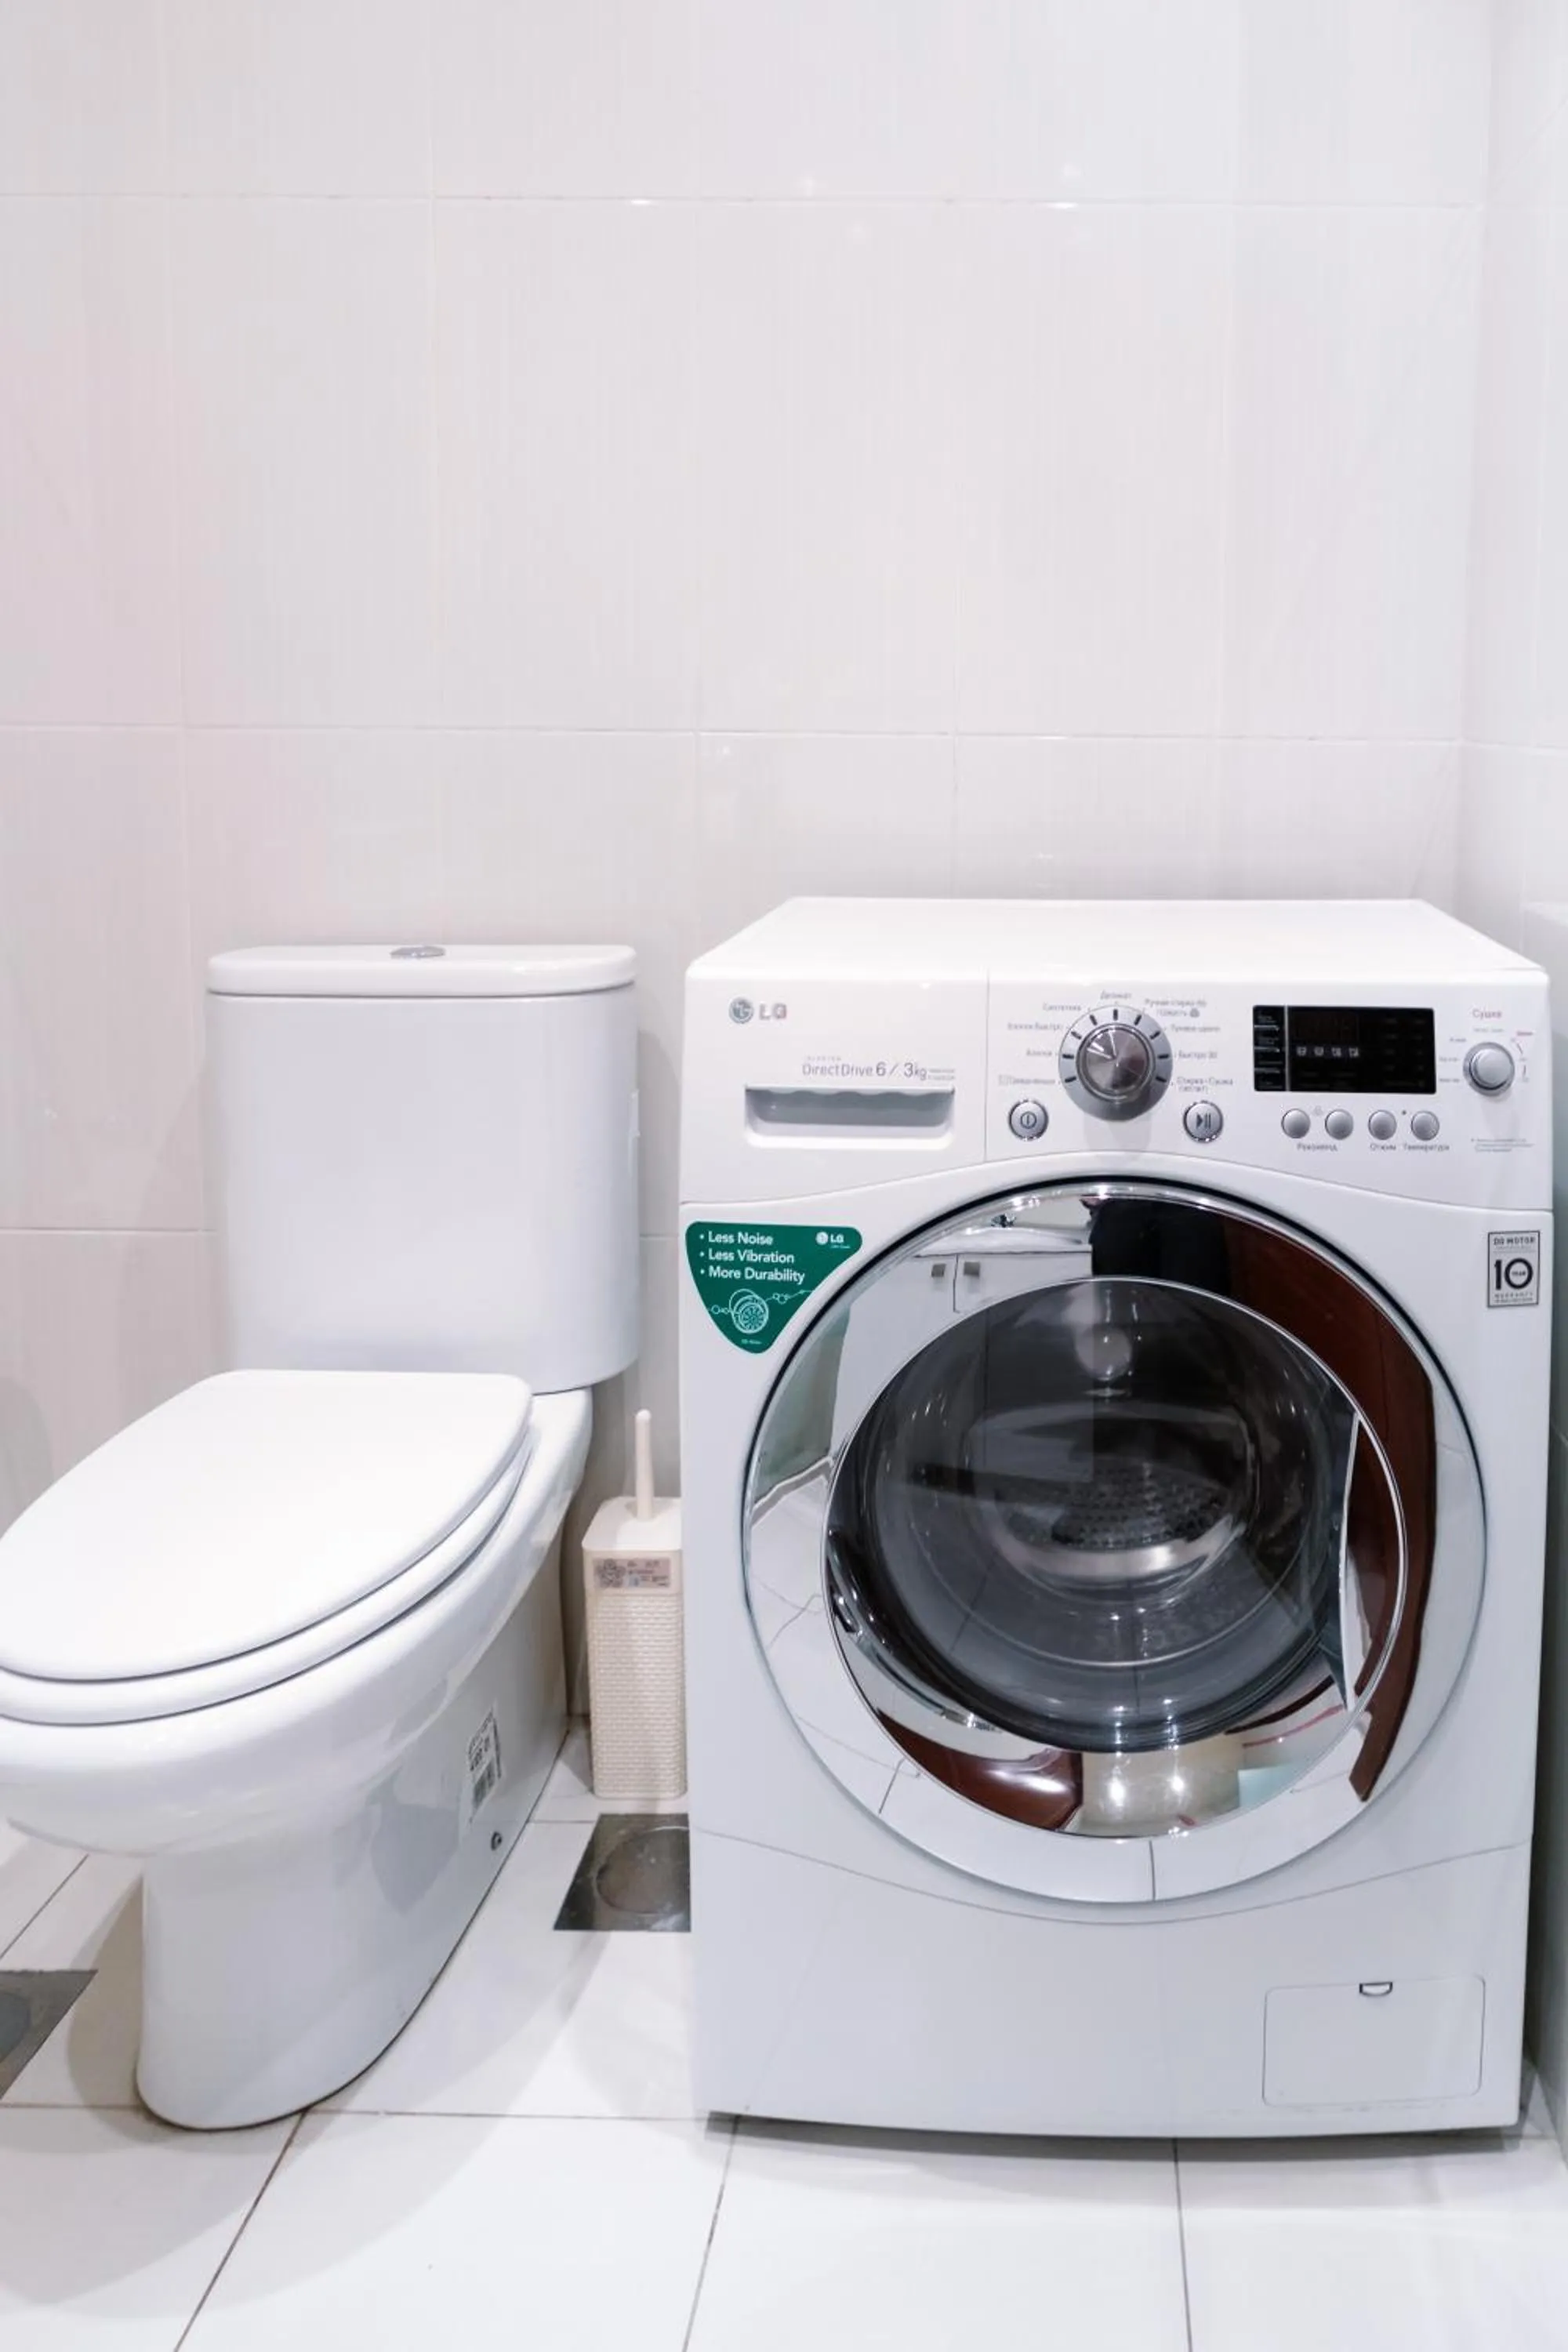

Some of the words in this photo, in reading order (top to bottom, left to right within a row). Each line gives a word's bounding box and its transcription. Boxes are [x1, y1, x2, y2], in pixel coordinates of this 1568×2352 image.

[759, 1003, 787, 1020] LG
[708, 1231, 735, 1243] Less
[738, 1232, 774, 1245] Noise
[708, 1248, 735, 1261] Less
[738, 1250, 794, 1263] Vibration
[709, 1265, 741, 1279] More
[745, 1268, 805, 1285] Durability
[1494, 1258, 1534, 1290] 10
